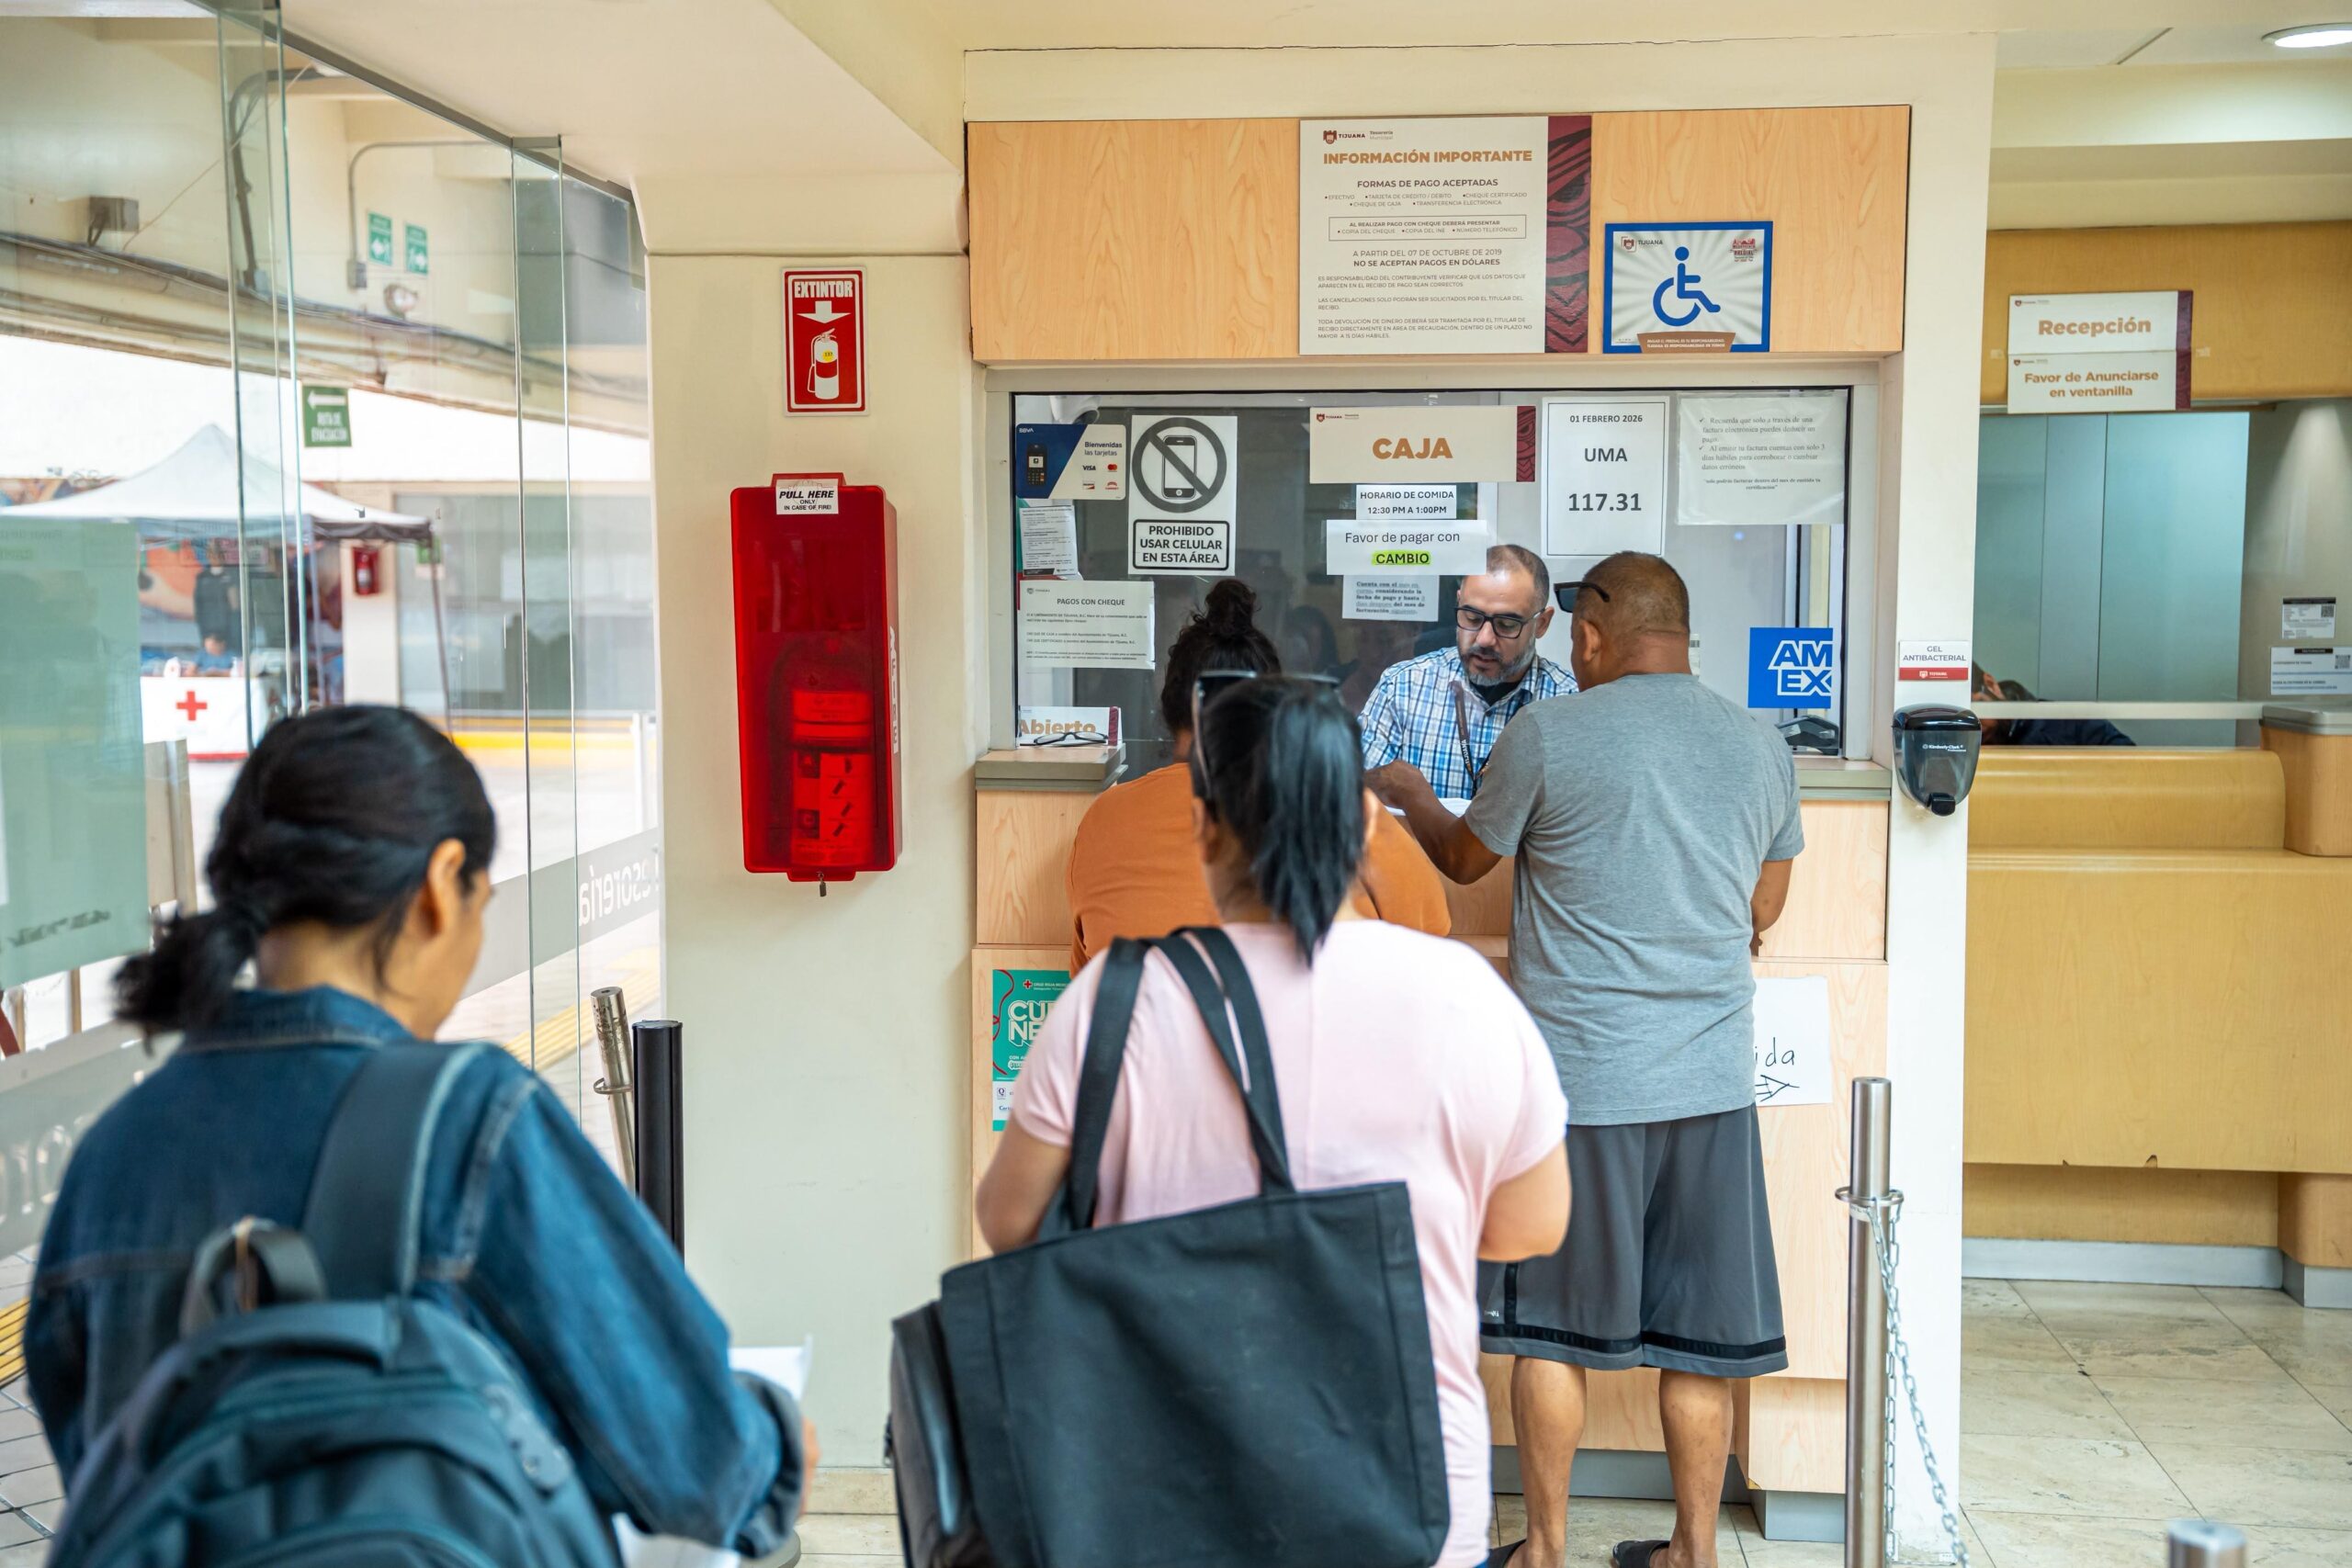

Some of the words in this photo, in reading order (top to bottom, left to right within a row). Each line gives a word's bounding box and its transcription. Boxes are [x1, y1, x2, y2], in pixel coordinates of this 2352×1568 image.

[1324, 150, 1430, 164] INFORMACIÓN
[1433, 150, 1532, 163] IMPORTANTE
[1357, 180, 1396, 188] FORMAS
[1442, 178, 1498, 187] ACEPTADAS
[794, 281, 854, 299] EXTINTOR
[2038, 317, 2152, 337] Recepción
[2024, 373, 2062, 383] Favor
[2064, 372, 2081, 382] de
[2086, 370, 2159, 382] Anunciarse
[2050, 388, 2065, 398] en
[2069, 387, 2133, 397] ventanilla
[1623, 414, 1643, 423] 2026
[1373, 438, 1453, 459] CAJA
[1584, 447, 1628, 462] UMA
[779, 491, 803, 499] PULL
[808, 491, 834, 499] HERE
[1360, 491, 1402, 500] HORARIO
[1568, 493, 1642, 512] 117.31
[1368, 506, 1391, 514] 12:30
[1392, 506, 1406, 514] PM
[1408, 506, 1413, 514] A
[1416, 506, 1447, 514] 1:00PM
[1148, 525, 1214, 536] PROHIBIDO
[1140, 538, 1170, 549] USAR
[1172, 539, 1222, 549] CELULAR
[1345, 532, 1378, 543] Favor
[1382, 532, 1396, 543] de
[1400, 532, 1435, 545] pagar
[1437, 532, 1460, 543] con
[1143, 553, 1158, 563] EN
[1160, 553, 1187, 563] ESTA
[1189, 553, 1219, 564] ÁREA
[1375, 553, 1430, 565] CAMBIO
[1769, 640, 1833, 670] AM
[1777, 669, 1832, 695] EX
[1020, 719, 1096, 735] Abierto
[1755, 1037, 1794, 1066] ida
